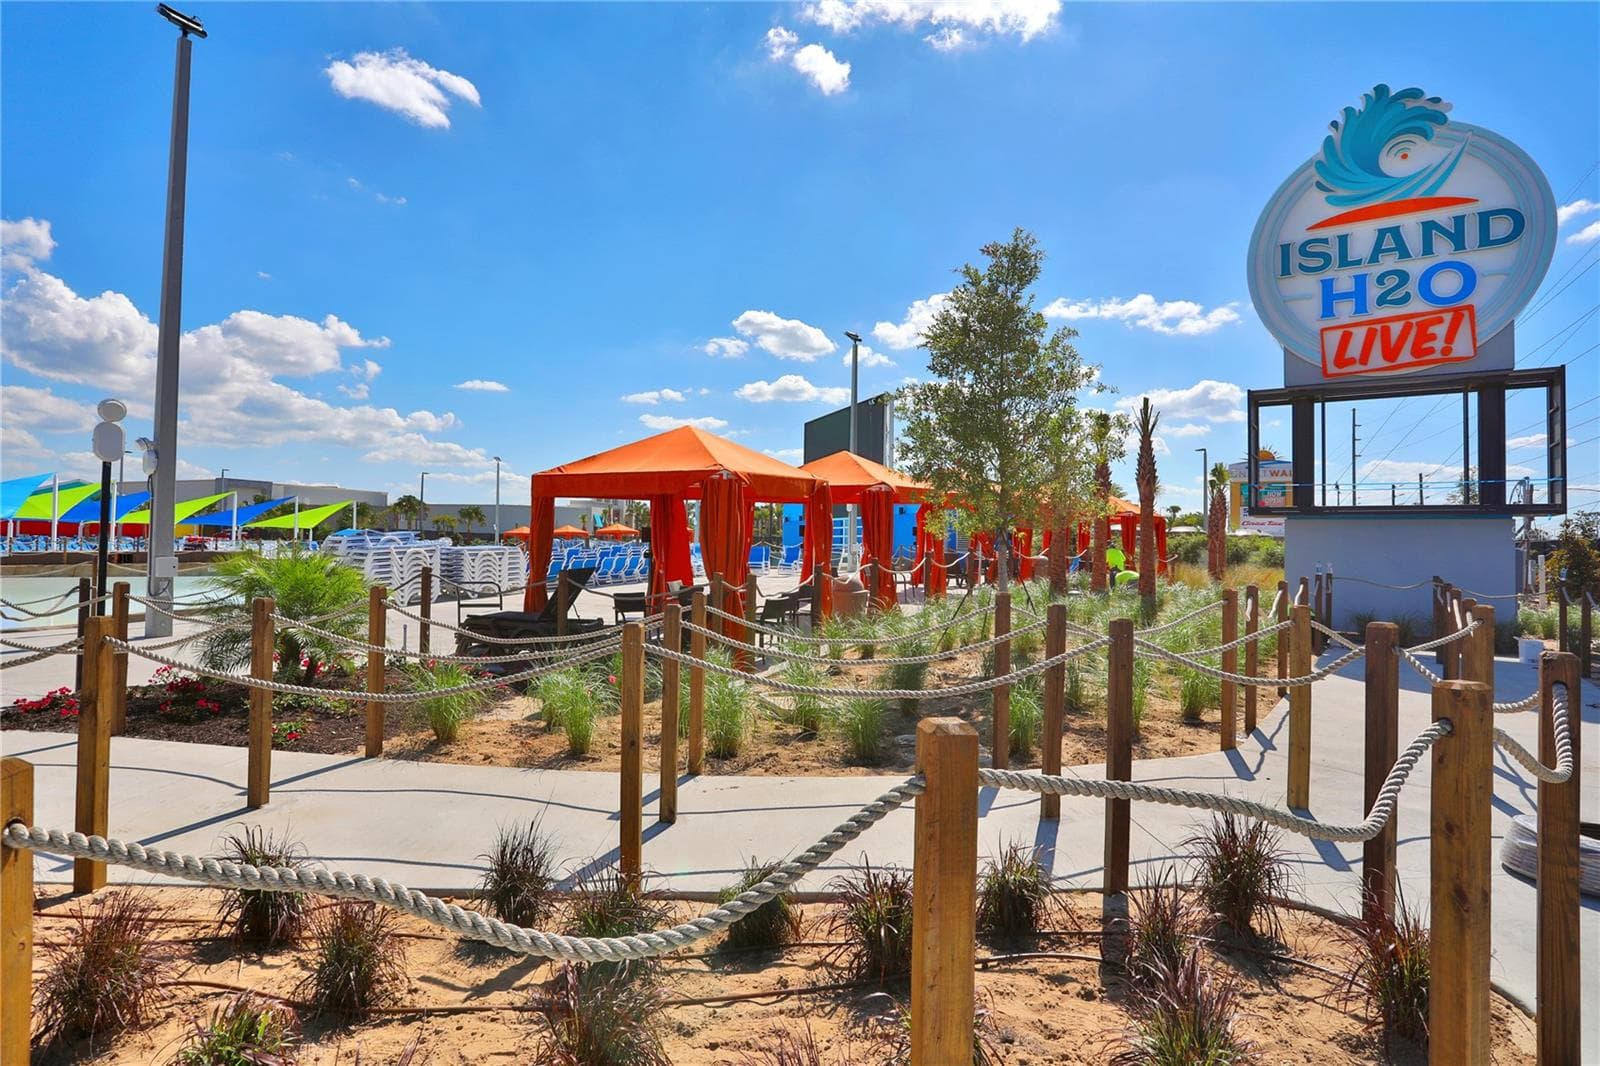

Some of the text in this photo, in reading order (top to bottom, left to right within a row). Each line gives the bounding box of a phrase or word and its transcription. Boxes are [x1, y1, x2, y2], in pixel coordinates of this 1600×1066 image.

[1279, 207, 1526, 278] ISLAND
[1320, 261, 1478, 320] H2O
[1333, 312, 1464, 369] LIVE!
